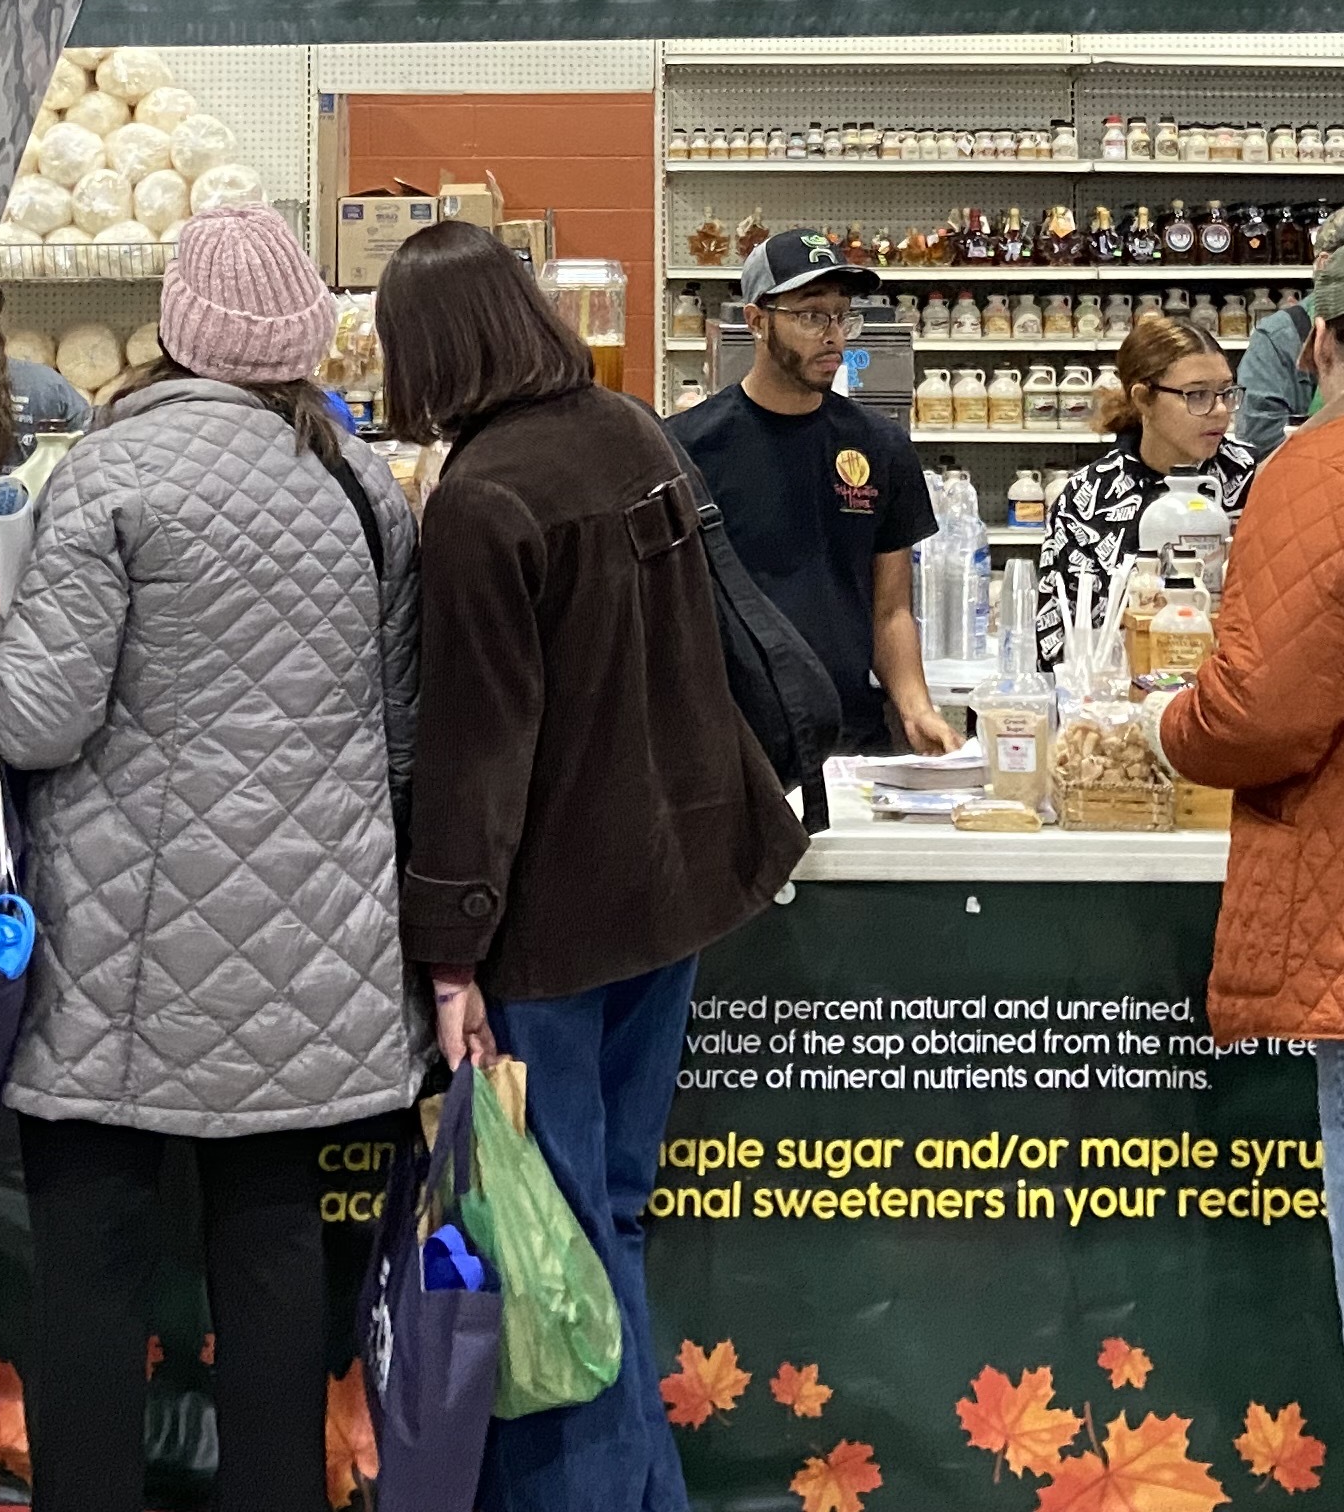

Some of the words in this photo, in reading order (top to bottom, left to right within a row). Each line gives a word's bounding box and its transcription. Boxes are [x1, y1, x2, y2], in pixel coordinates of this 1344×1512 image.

[775, 997, 883, 1024] percent
[891, 996, 986, 1020] natural
[994, 996, 1049, 1020] and
[1057, 996, 1194, 1023] unrefined,
[686, 1029, 761, 1054] value
[769, 1029, 796, 1053] of
[803, 1030, 845, 1054] the
[852, 1033, 905, 1059] sap
[912, 1029, 1036, 1054] obtained
[1044, 1028, 1109, 1054] from
[1117, 1030, 1161, 1054] the
[676, 1068, 758, 1088] ource
[766, 1064, 793, 1088] of
[800, 1064, 906, 1088] mineral
[914, 1064, 1027, 1088] nutrients
[1034, 1064, 1089, 1088] and
[1096, 1063, 1213, 1089] vitamins.
[776, 1138, 904, 1179] sugar
[915, 1131, 1069, 1169] and/or
[1080, 1131, 1219, 1176] maple
[753, 1181, 1006, 1219] sweeteners
[1017, 1179, 1055, 1218] in
[1064, 1186, 1166, 1227] your
